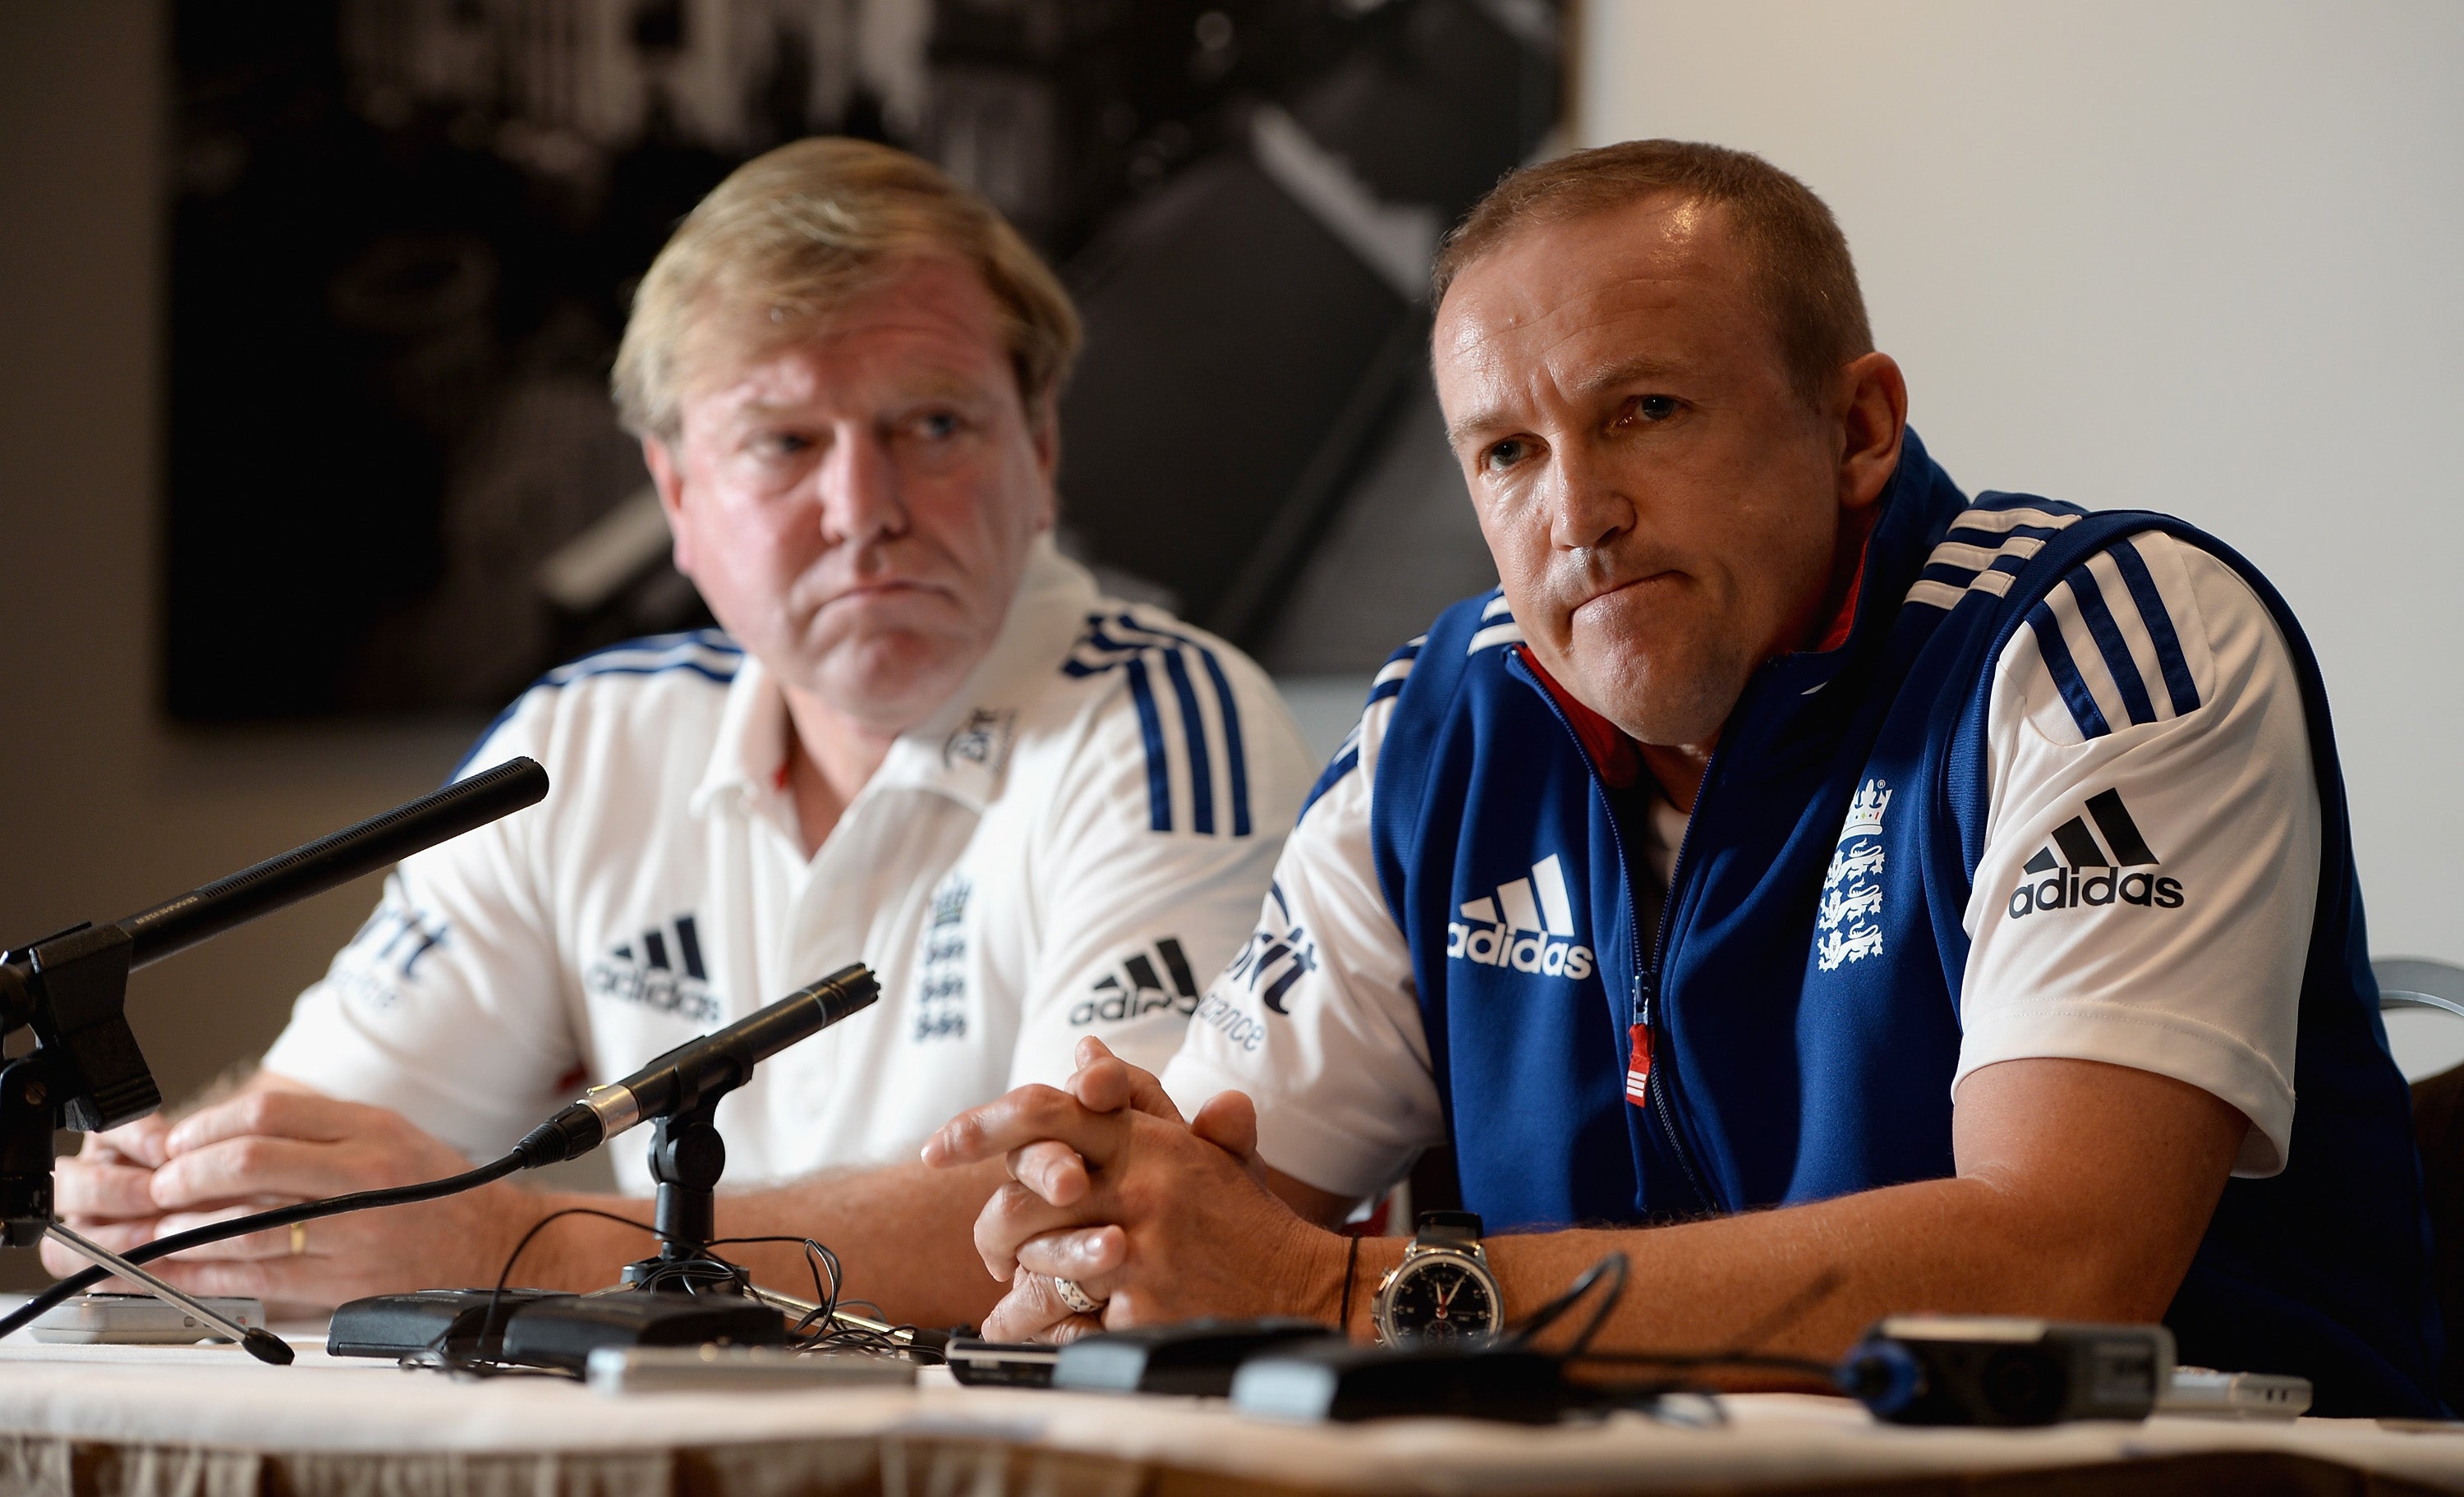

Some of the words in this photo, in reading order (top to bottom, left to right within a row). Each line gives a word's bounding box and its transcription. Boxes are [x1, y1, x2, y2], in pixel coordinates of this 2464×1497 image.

[2009, 866, 2185, 920] adidas
[1446, 921, 1594, 980] adidas
[587, 962, 719, 1022] adidas
